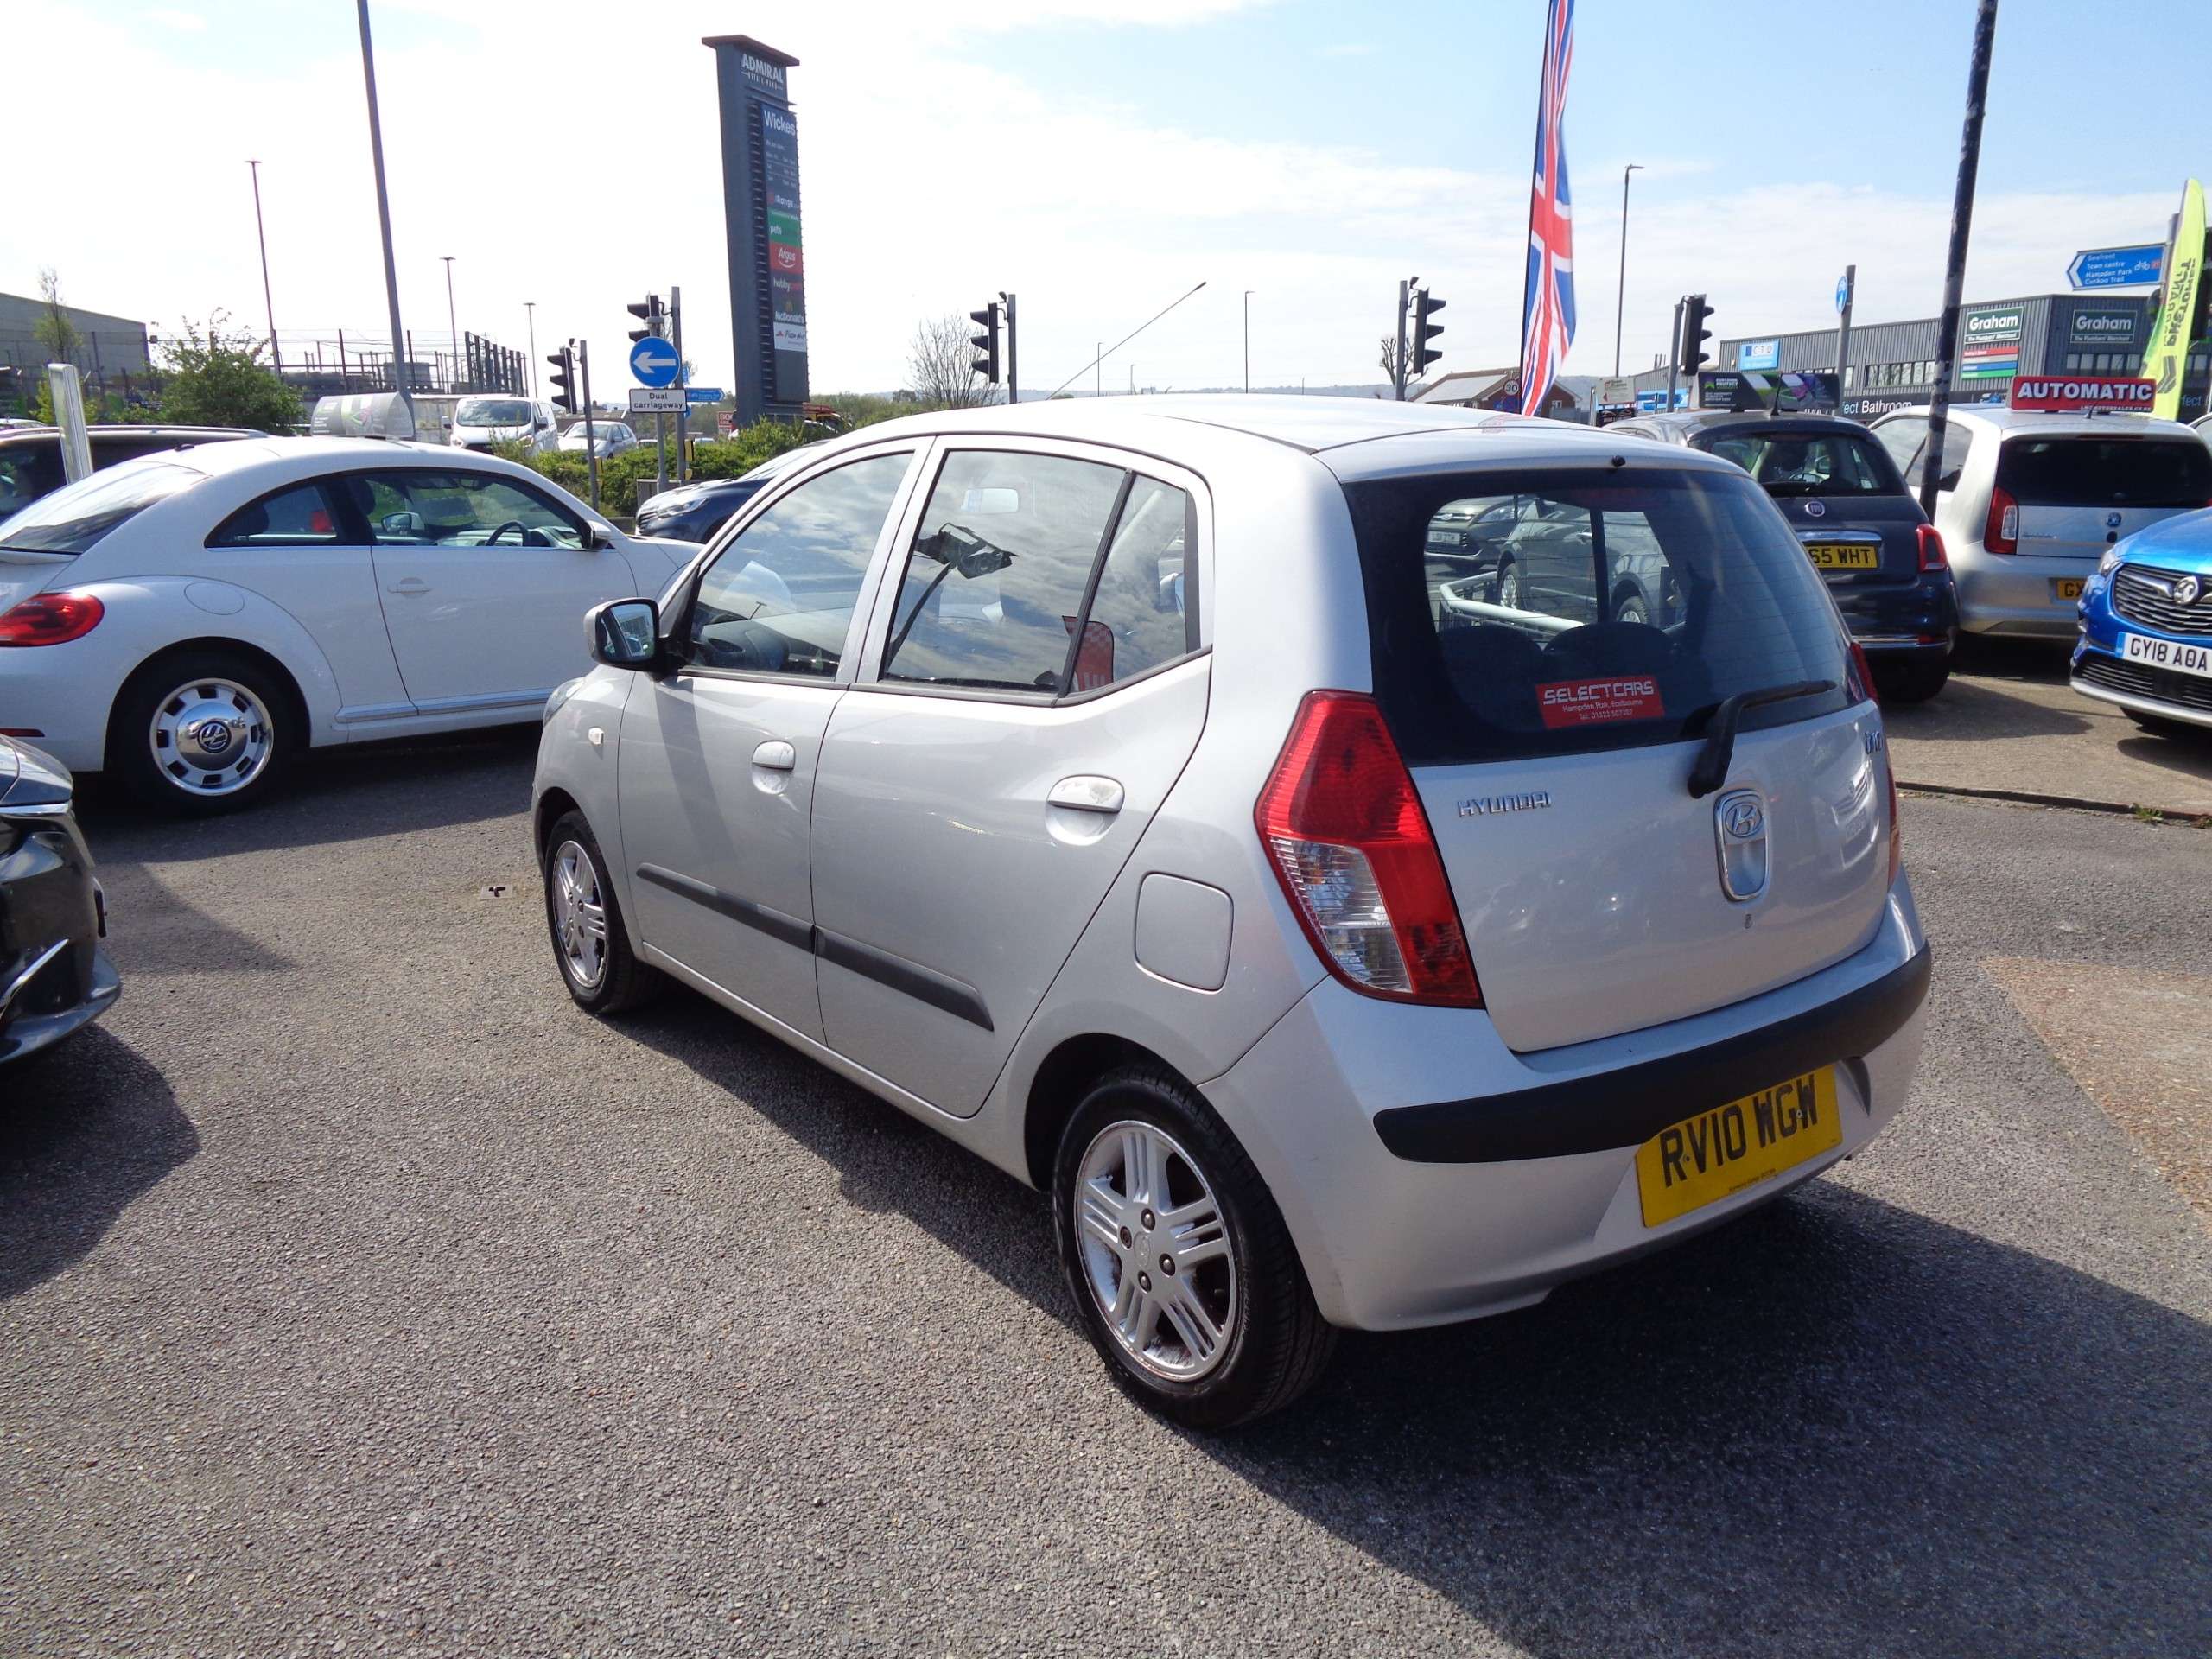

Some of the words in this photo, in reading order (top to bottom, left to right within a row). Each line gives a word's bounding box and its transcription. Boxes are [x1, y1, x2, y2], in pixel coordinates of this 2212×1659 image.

[741, 53, 784, 84] ADMIRAL
[764, 110, 796, 136] Wickes
[778, 247, 796, 264] Argos
[1969, 315, 2019, 331] Graham
[2076, 315, 2132, 330] Graham
[1506, 383, 1517, 392] 30
[2017, 382, 2153, 401] AUTOMATIC
[633, 401, 683, 410] carriageway
[1836, 548, 1871, 564] WHT
[2130, 637, 2168, 662] GY18
[1457, 791, 1552, 818] HYUNDAI
[1659, 1103, 1748, 1189] RV10
[1752, 1073, 1818, 1148] WGW
